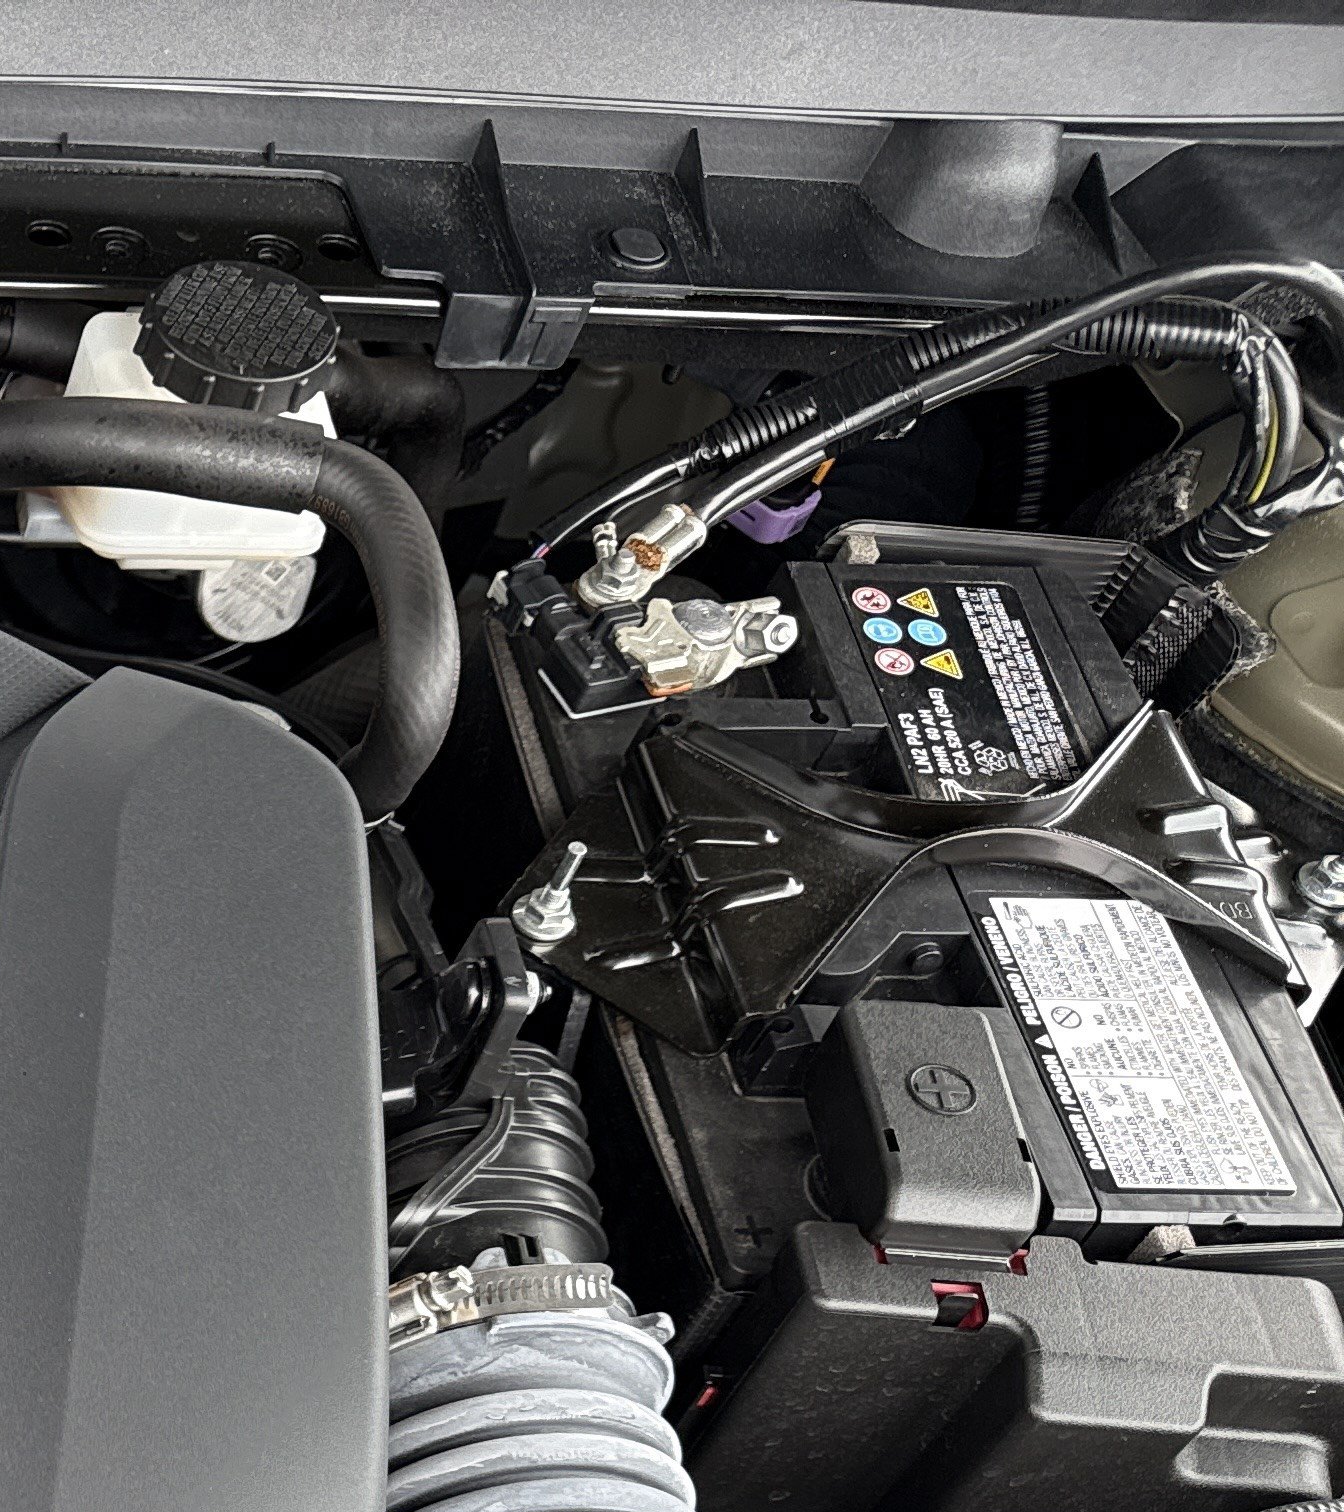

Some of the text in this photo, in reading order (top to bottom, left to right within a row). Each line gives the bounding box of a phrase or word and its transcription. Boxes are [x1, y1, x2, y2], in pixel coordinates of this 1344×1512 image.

[925, 687, 954, 717] (SAE)
[895, 713, 935, 773] LN2 PAF3
[916, 709, 955, 774] 20HR 60 AH
[942, 729, 966, 748] 520
[949, 750, 976, 775] CCA
[979, 916, 1107, 1169] DANGER POISON PELIGRO VENENO
